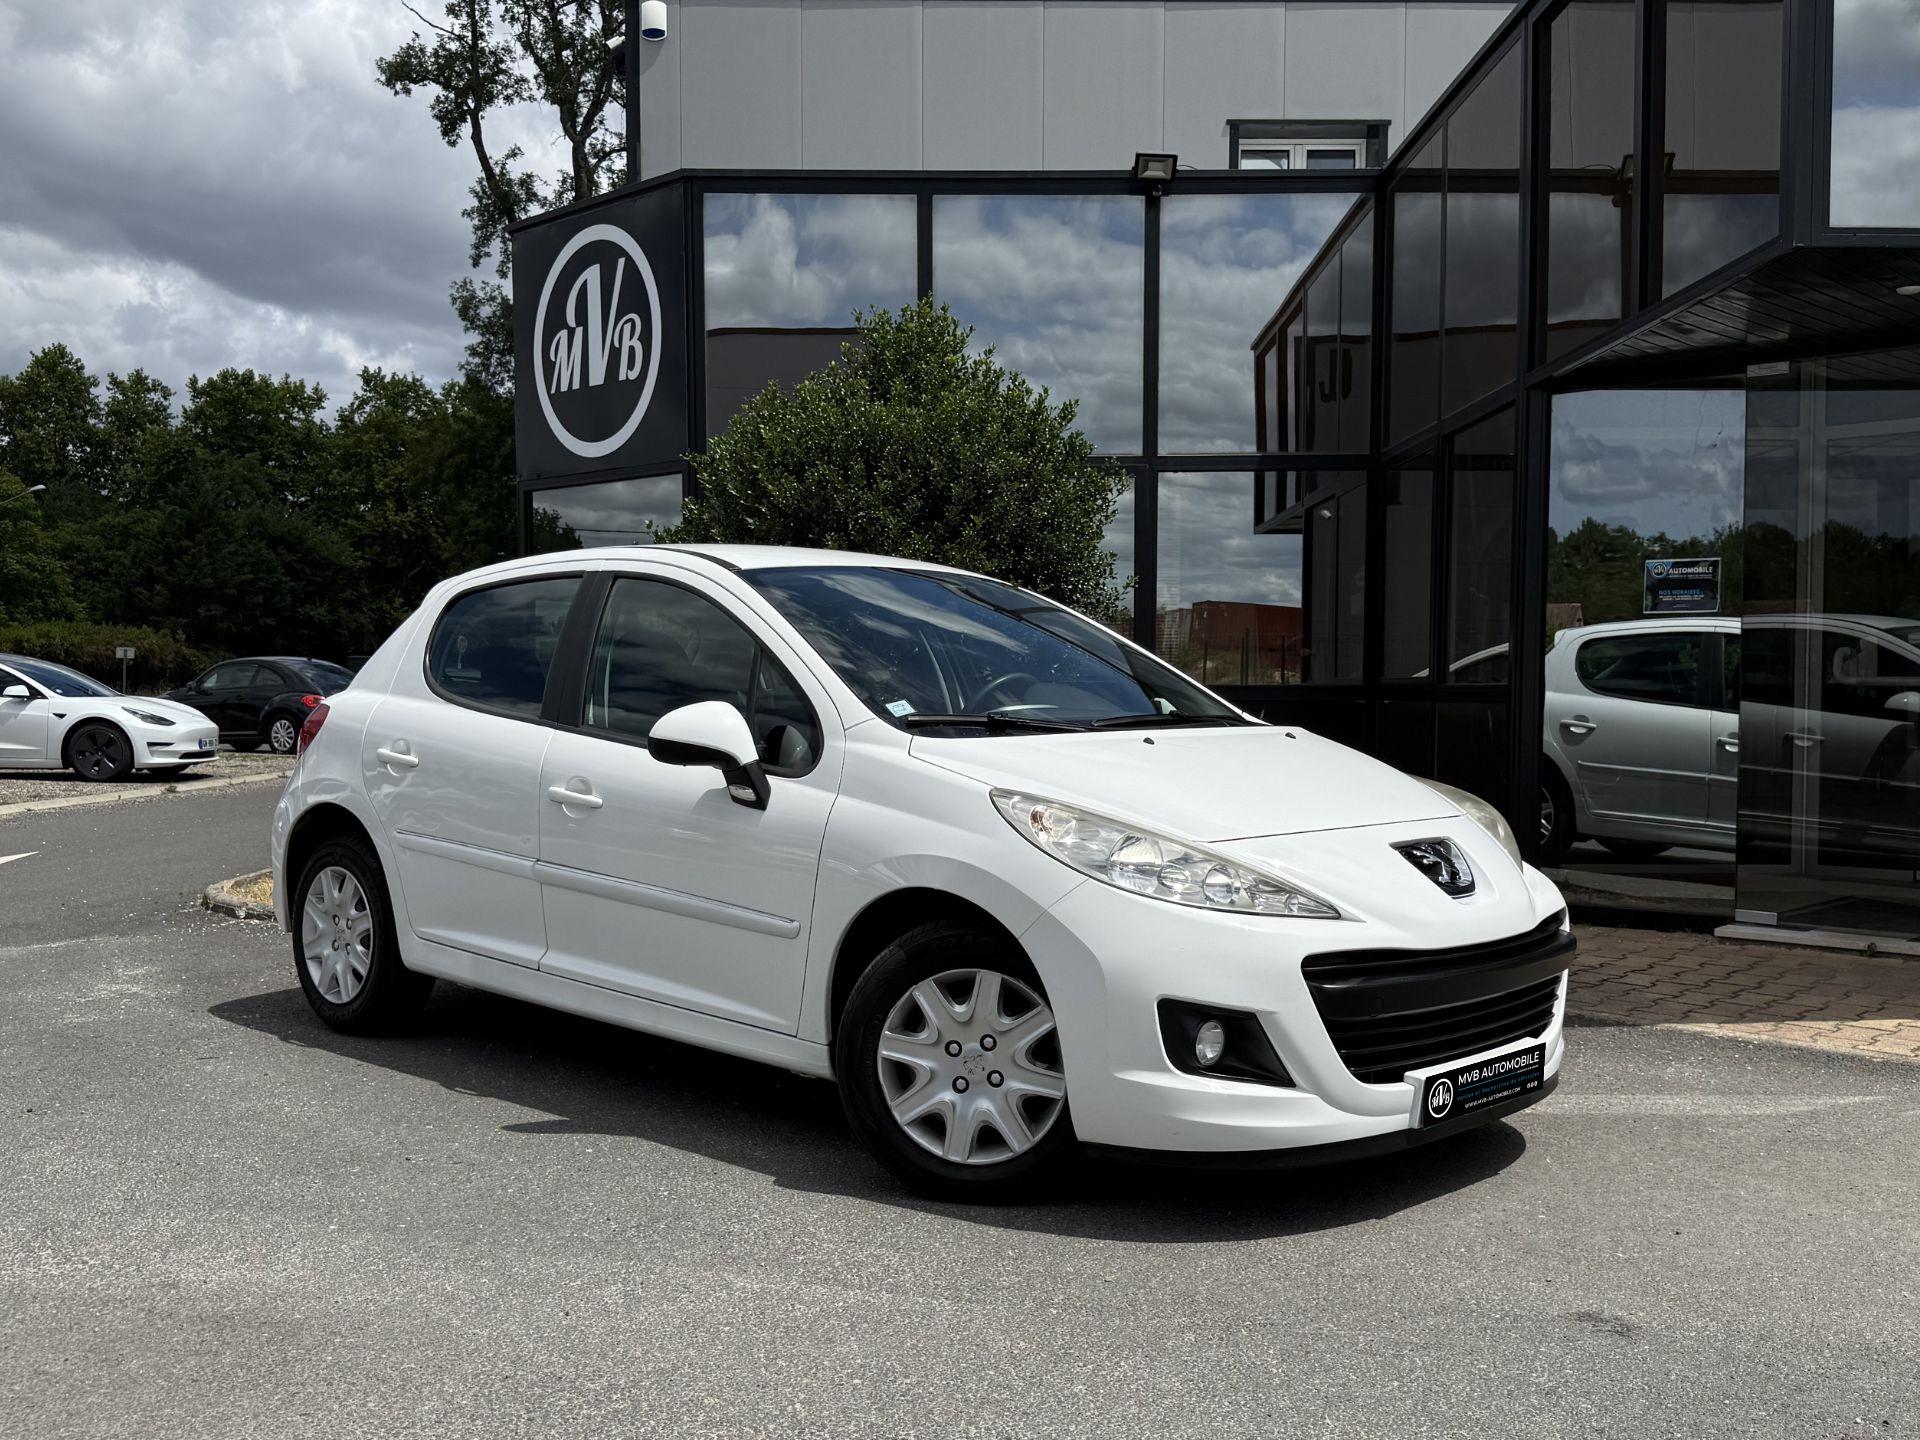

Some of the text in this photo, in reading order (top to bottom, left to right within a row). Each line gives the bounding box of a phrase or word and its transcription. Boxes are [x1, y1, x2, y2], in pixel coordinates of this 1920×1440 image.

[550, 257, 643, 394] MVB
[1668, 566, 1713, 574] AUTOMOBILE
[1458, 1070, 1480, 1086] MVB
[1481, 1051, 1540, 1079] AUTOMOBILE
[1431, 1083, 1450, 1108] MVB
